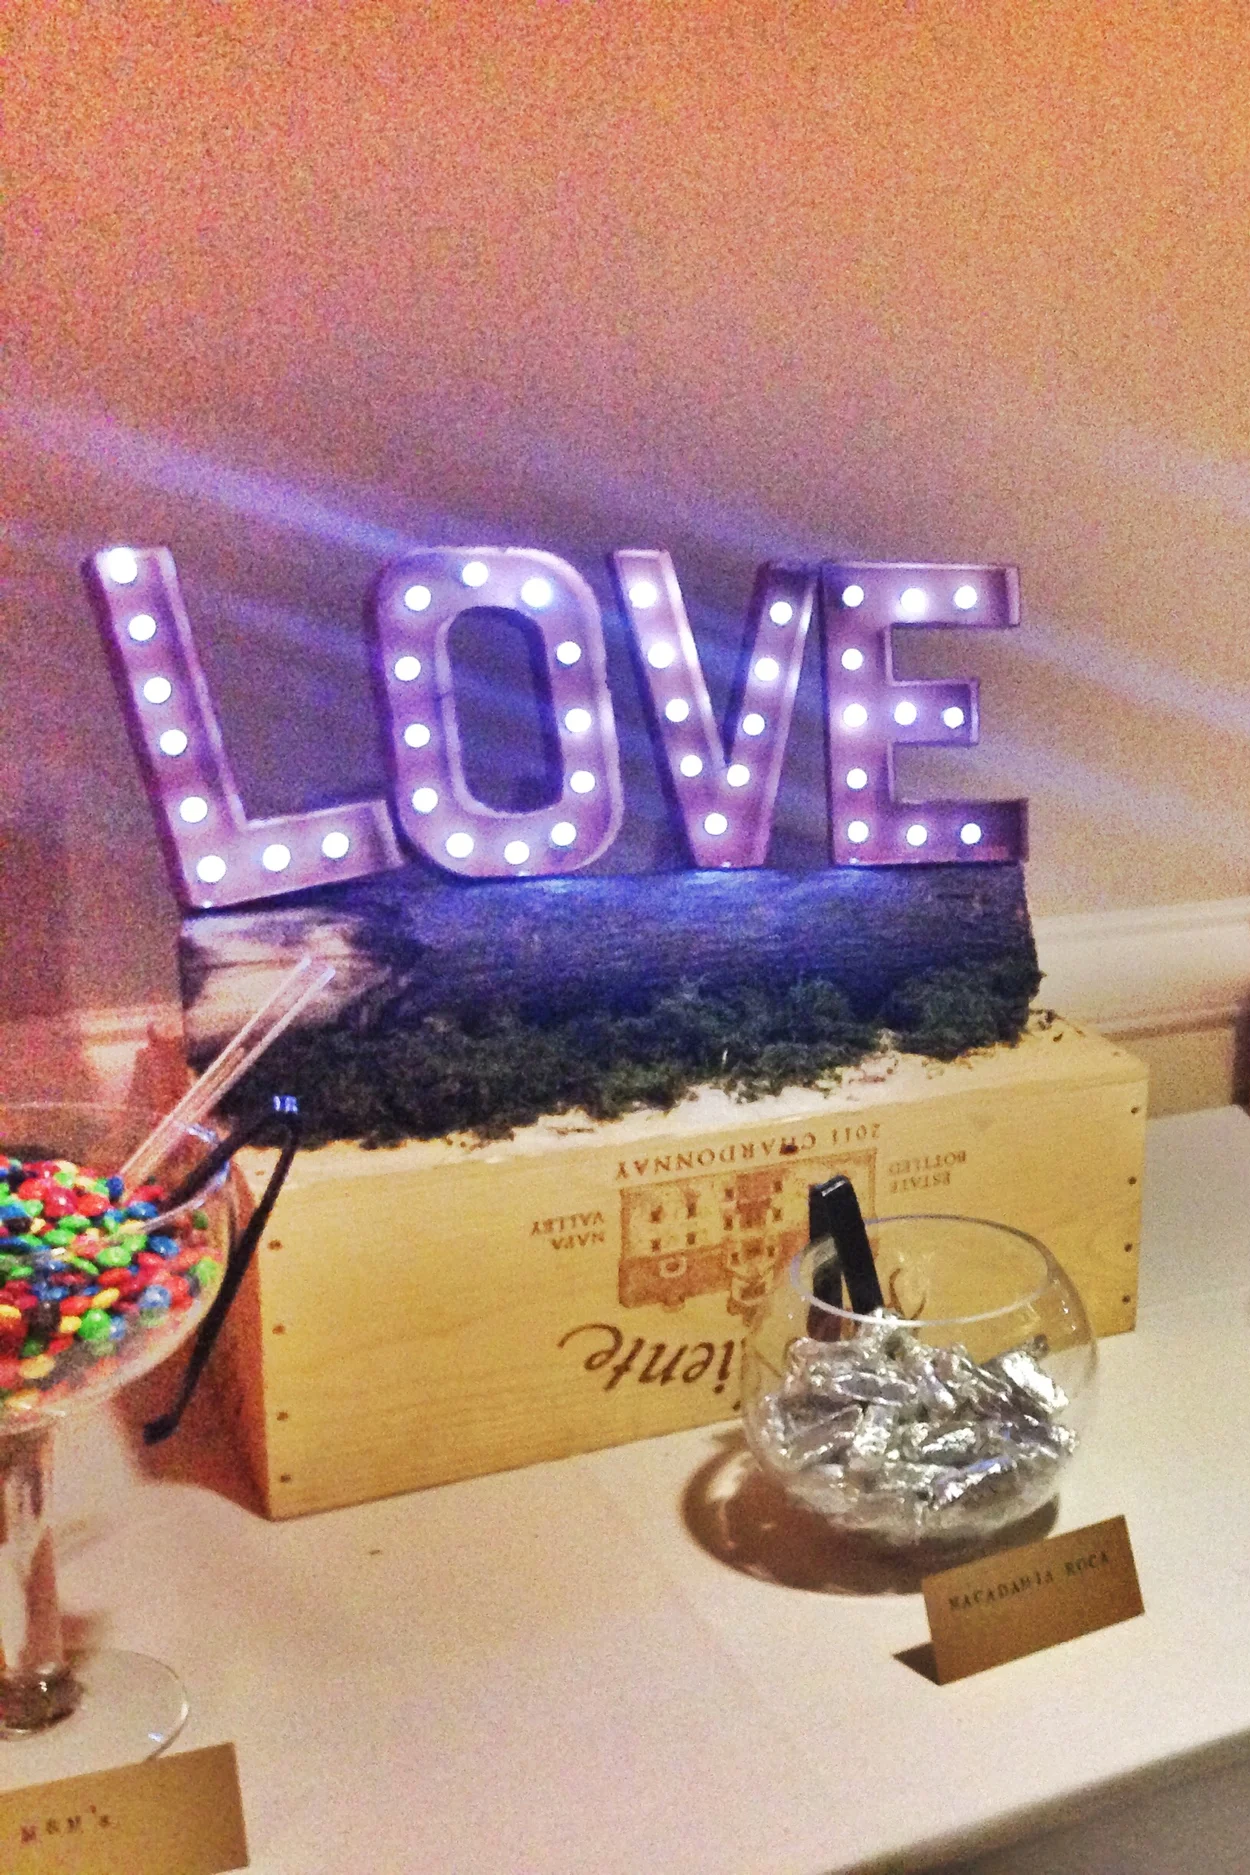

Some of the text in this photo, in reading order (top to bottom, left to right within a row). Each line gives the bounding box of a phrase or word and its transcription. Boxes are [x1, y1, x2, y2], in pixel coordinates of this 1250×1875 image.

[83, 544, 1027, 908] LOVE
[614, 1123, 880, 1180] 2011 CHARDONNAY
[888, 1149, 967, 1176] BOTTLED
[531, 1211, 606, 1237] VALLEY
[551, 1230, 606, 1251] NAPA
[948, 1551, 1110, 1612] MACADAMIA ROCA
